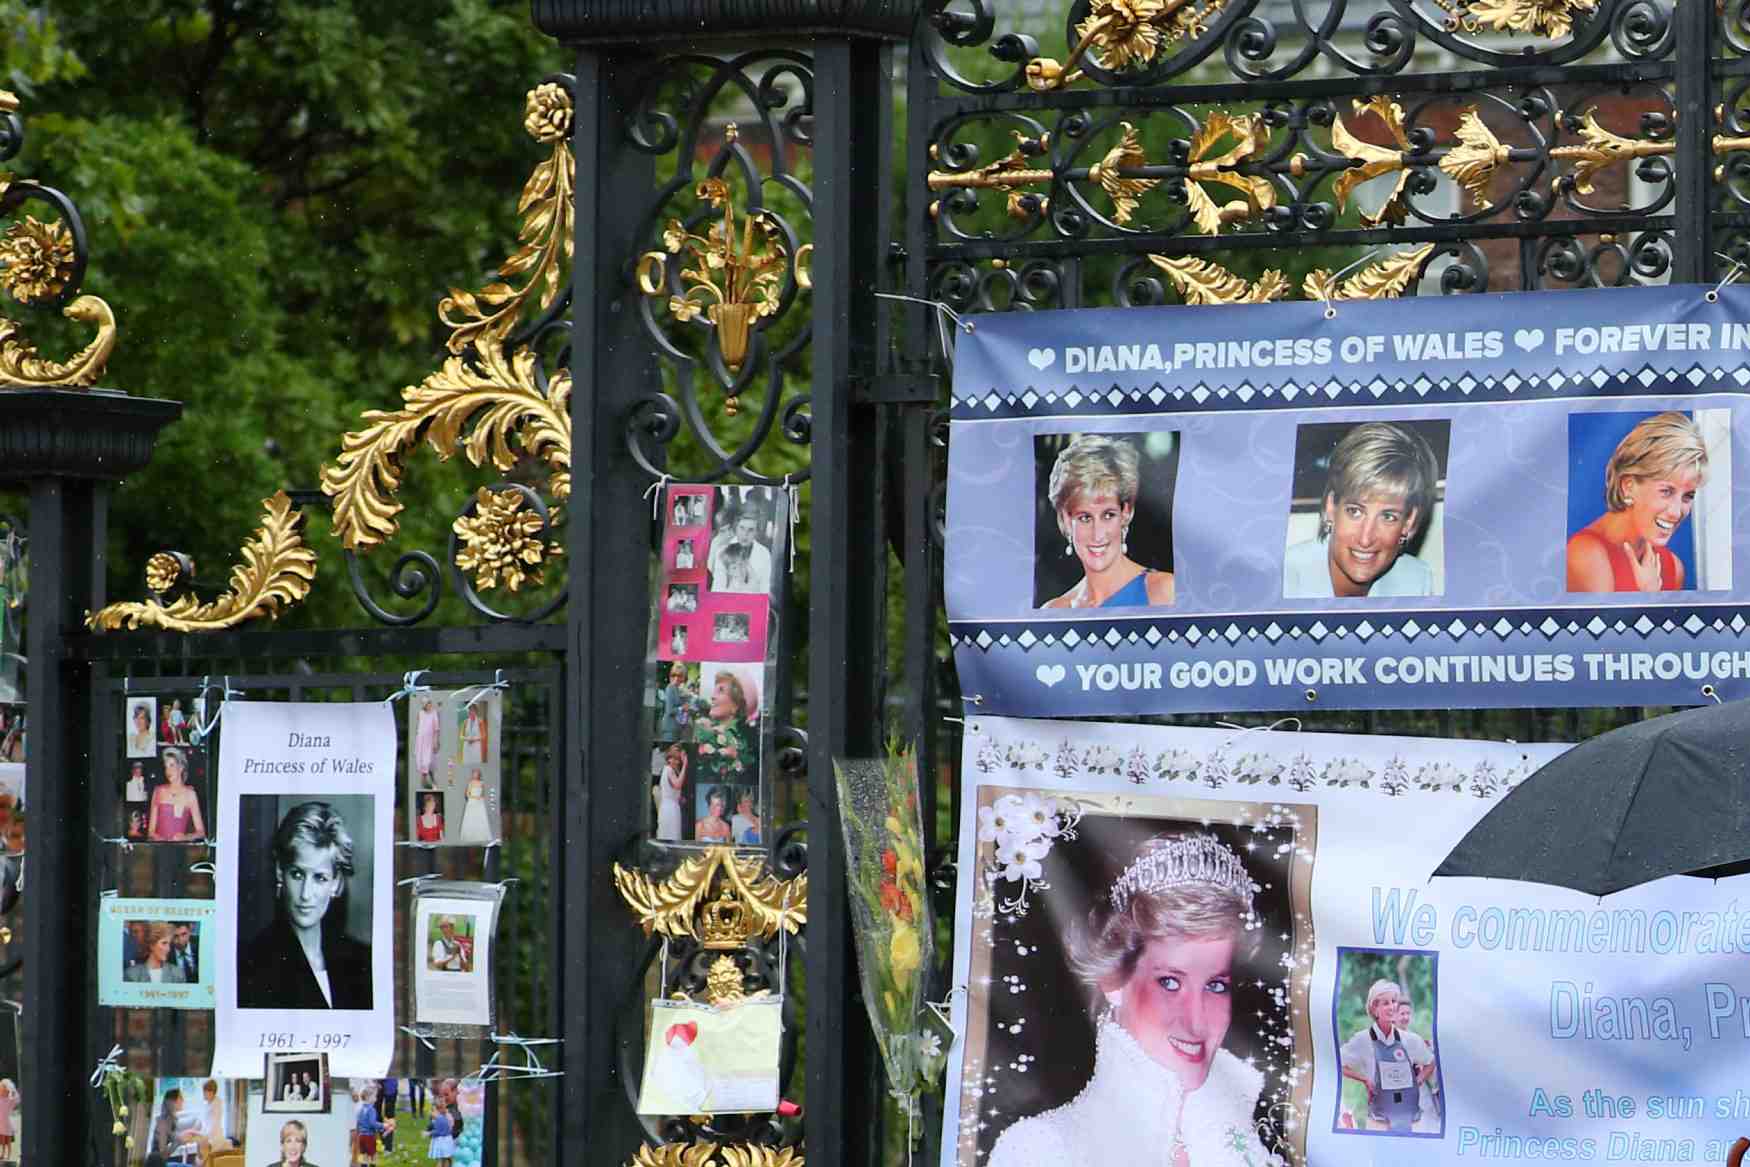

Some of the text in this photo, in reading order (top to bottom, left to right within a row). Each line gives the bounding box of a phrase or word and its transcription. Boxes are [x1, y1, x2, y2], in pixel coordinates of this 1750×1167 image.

[1340, 335, 1384, 364] OF
[1393, 330, 1504, 362] WALES
[1555, 322, 1712, 356] FOREVER
[1076, 663, 1162, 692] YOUR
[1169, 660, 1258, 689] GOOD
[1265, 657, 1367, 687] WORK
[1374, 653, 1575, 685] CONTINUES
[288, 732, 331, 749] Diana
[243, 757, 374, 776] Princess of Wales
[1371, 887, 1437, 946] We
[1550, 980, 1692, 1051] Diana,
[258, 1033, 296, 1049] 1961
[313, 1034, 351, 1050] 1997
[1529, 1087, 1574, 1119] As
[1583, 1088, 1636, 1119] the
[1646, 1095, 1705, 1119] sun
[1457, 1125, 1598, 1160] Princess
[1606, 1131, 1696, 1162] Diana
